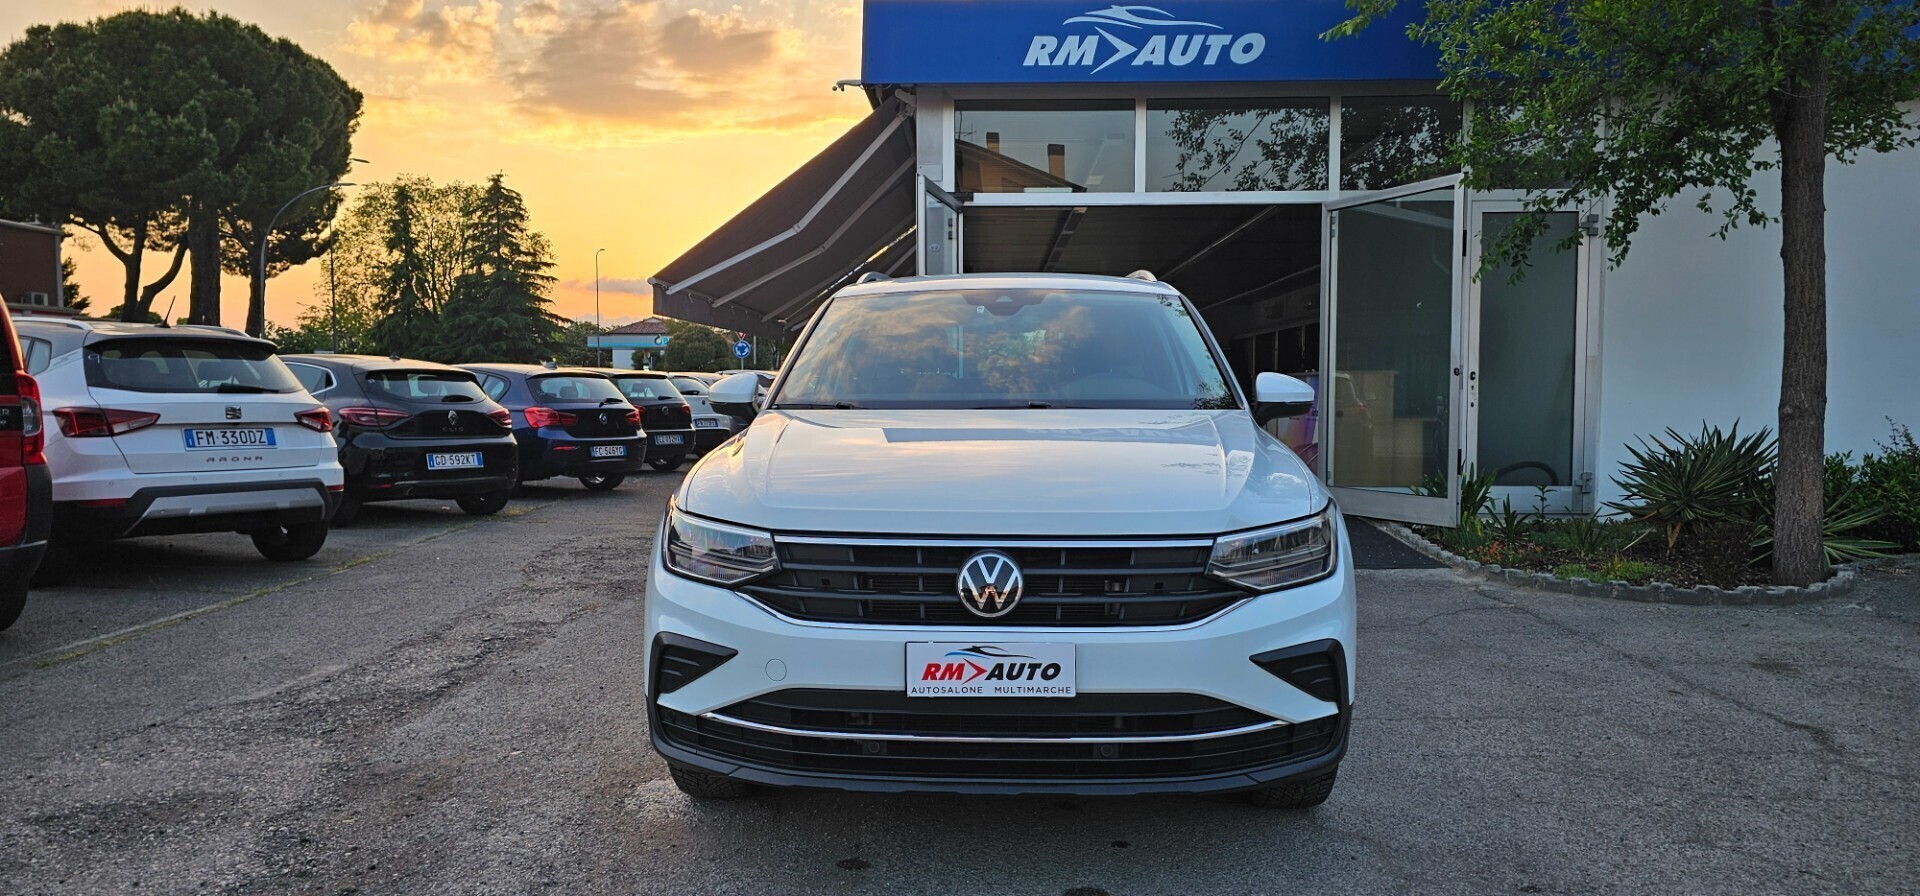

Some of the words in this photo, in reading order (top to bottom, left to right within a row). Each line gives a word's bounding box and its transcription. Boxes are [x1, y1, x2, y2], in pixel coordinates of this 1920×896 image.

[1022, 35, 1100, 67] RM
[1130, 32, 1267, 66] AUTO
[921, 663, 966, 681] RM
[984, 662, 1063, 681] AUTO
[911, 686, 983, 694] AUTOSALONE
[994, 686, 1072, 694] MULTIMARCHE
